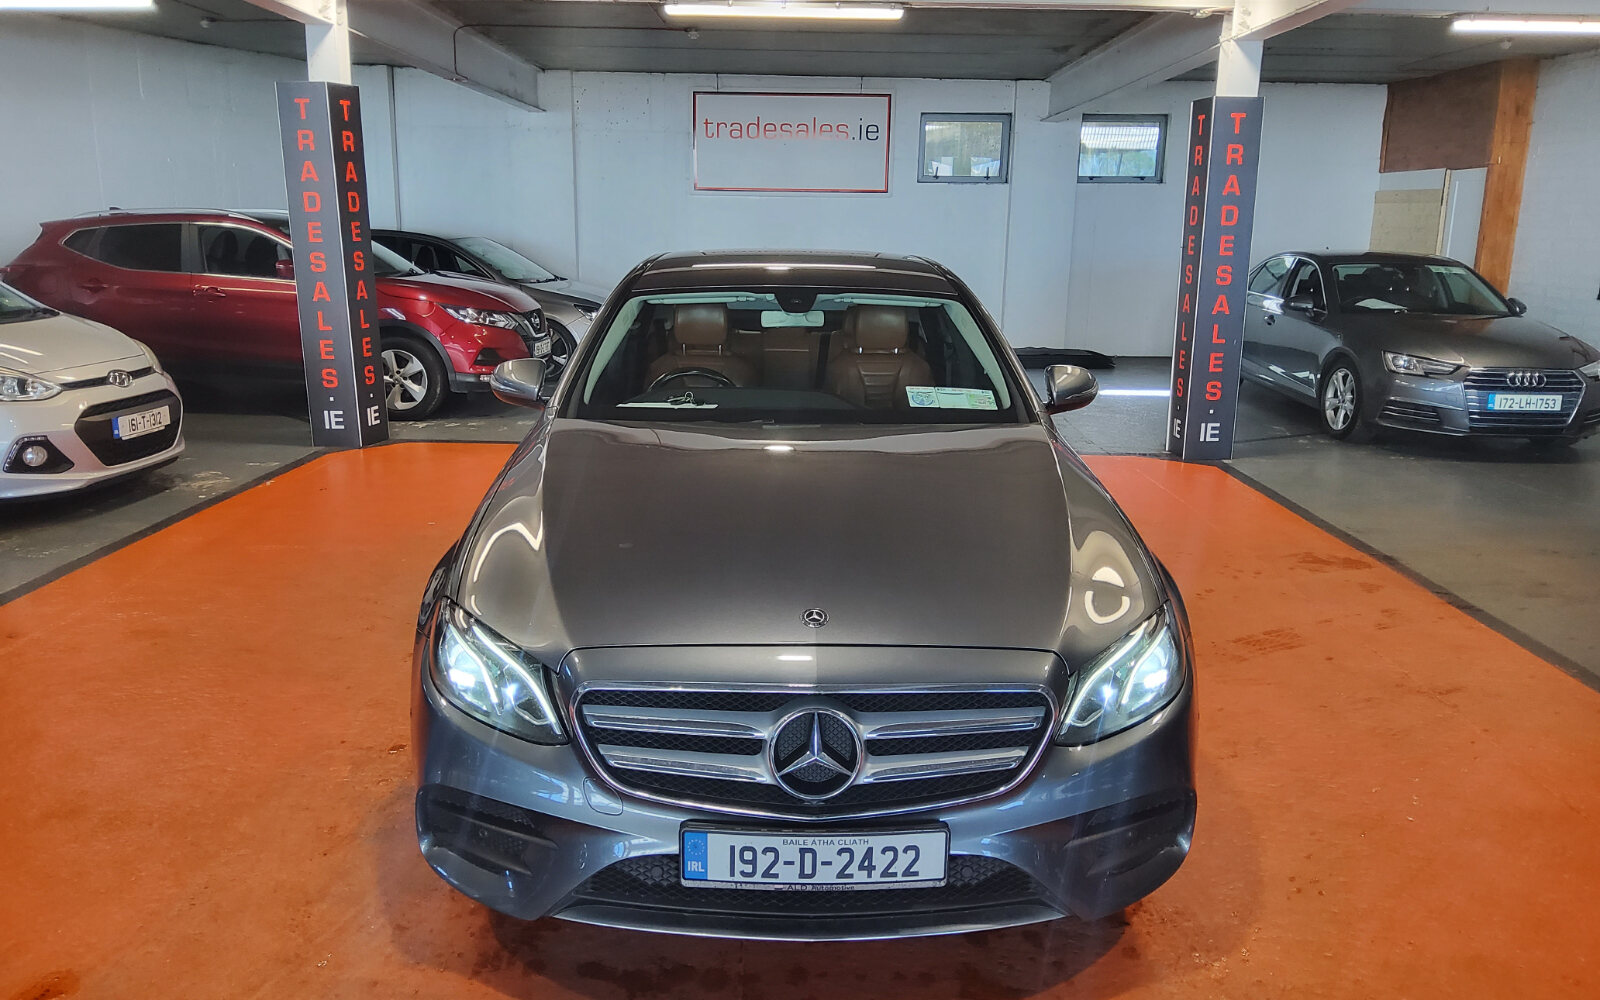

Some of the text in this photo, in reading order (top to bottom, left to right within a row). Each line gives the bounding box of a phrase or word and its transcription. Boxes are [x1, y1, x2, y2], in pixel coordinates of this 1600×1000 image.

[703, 116, 880, 141] tradesales.ie
[1499, 397, 1557, 409] 172-LH-1753
[128, 411, 163, 433] 161-T-1312
[837, 838, 869, 846] CLIATH
[687, 860, 705, 873] IRL
[729, 844, 921, 880] 192-D-2422
